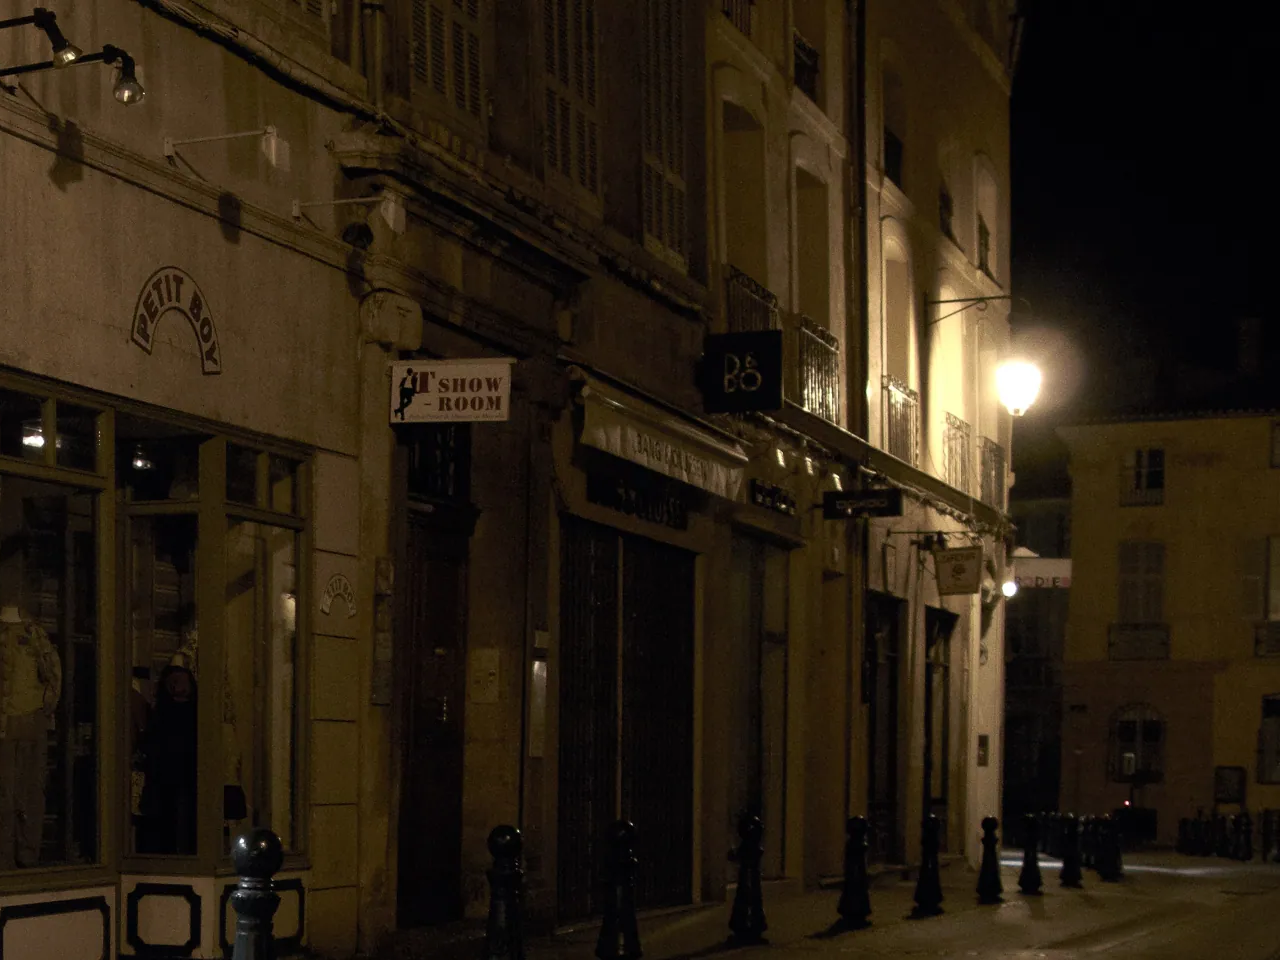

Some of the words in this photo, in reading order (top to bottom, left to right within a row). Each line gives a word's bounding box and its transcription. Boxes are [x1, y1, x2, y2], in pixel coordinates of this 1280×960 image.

[136, 274, 184, 344] PETIT
[189, 290, 218, 366] BOY
[438, 377, 502, 393] SHOW
[438, 396, 502, 411] ROOM
